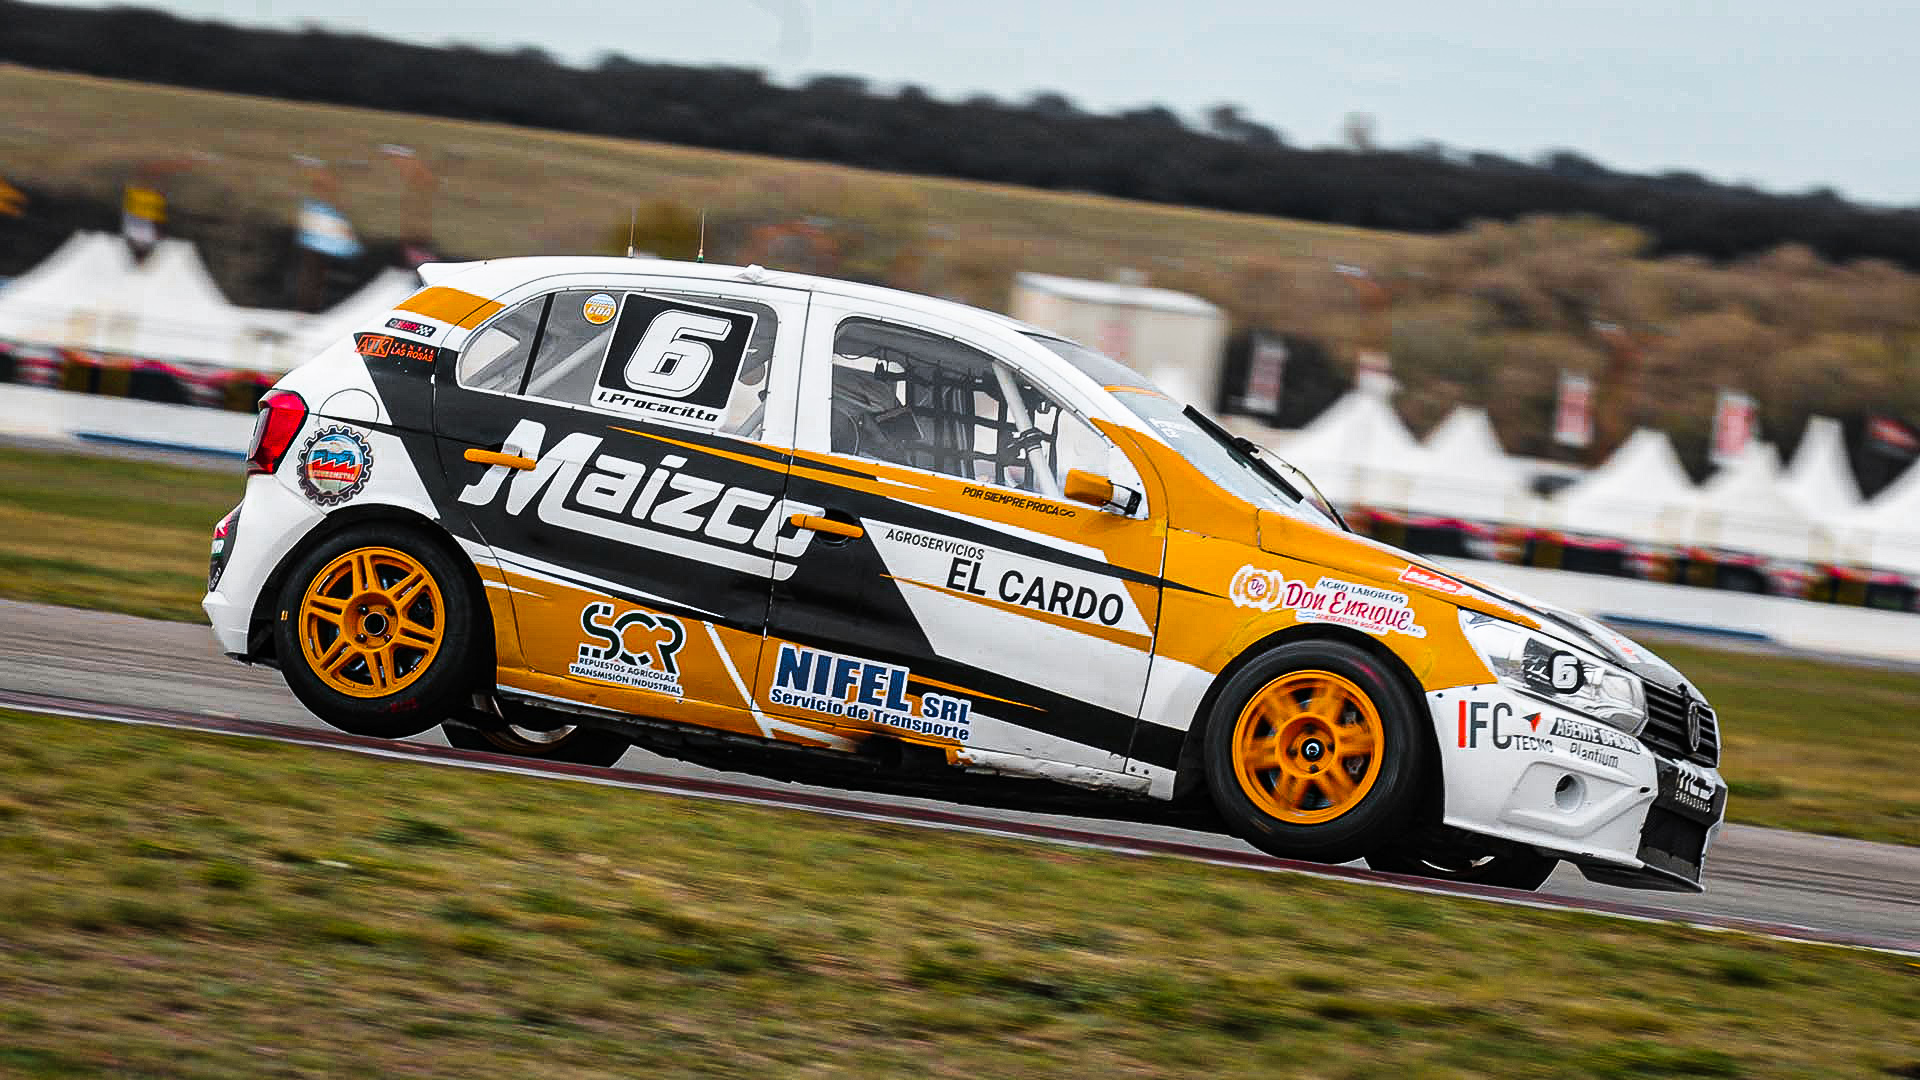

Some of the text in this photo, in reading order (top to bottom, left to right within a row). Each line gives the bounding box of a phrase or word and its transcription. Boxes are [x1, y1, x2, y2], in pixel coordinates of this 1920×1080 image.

[359, 336, 390, 355] ATK
[390, 347, 434, 362] LAS ROSAS
[623, 308, 733, 398] 6
[598, 391, 719, 423] I.Procacitto
[457, 418, 825, 582] Maizco
[962, 486, 1058, 516] POR SIEMPRE PROCA
[885, 529, 985, 560] AGROSERVICIOS
[946, 557, 1124, 625] EL CARDO
[1319, 579, 1404, 604] AGRO LABOREOS
[579, 604, 684, 674] SCR
[570, 665, 681, 695] TRANSMISION INDUSTRIAL
[579, 657, 675, 683] REPUESTOS AGRICOLAS
[776, 646, 970, 725] NIFEL SRL
[1552, 655, 1578, 690] 6
[771, 688, 969, 741] Servicio de Transporte
[1458, 700, 1513, 750] IFC
[1556, 720, 1601, 743] AGENTE
